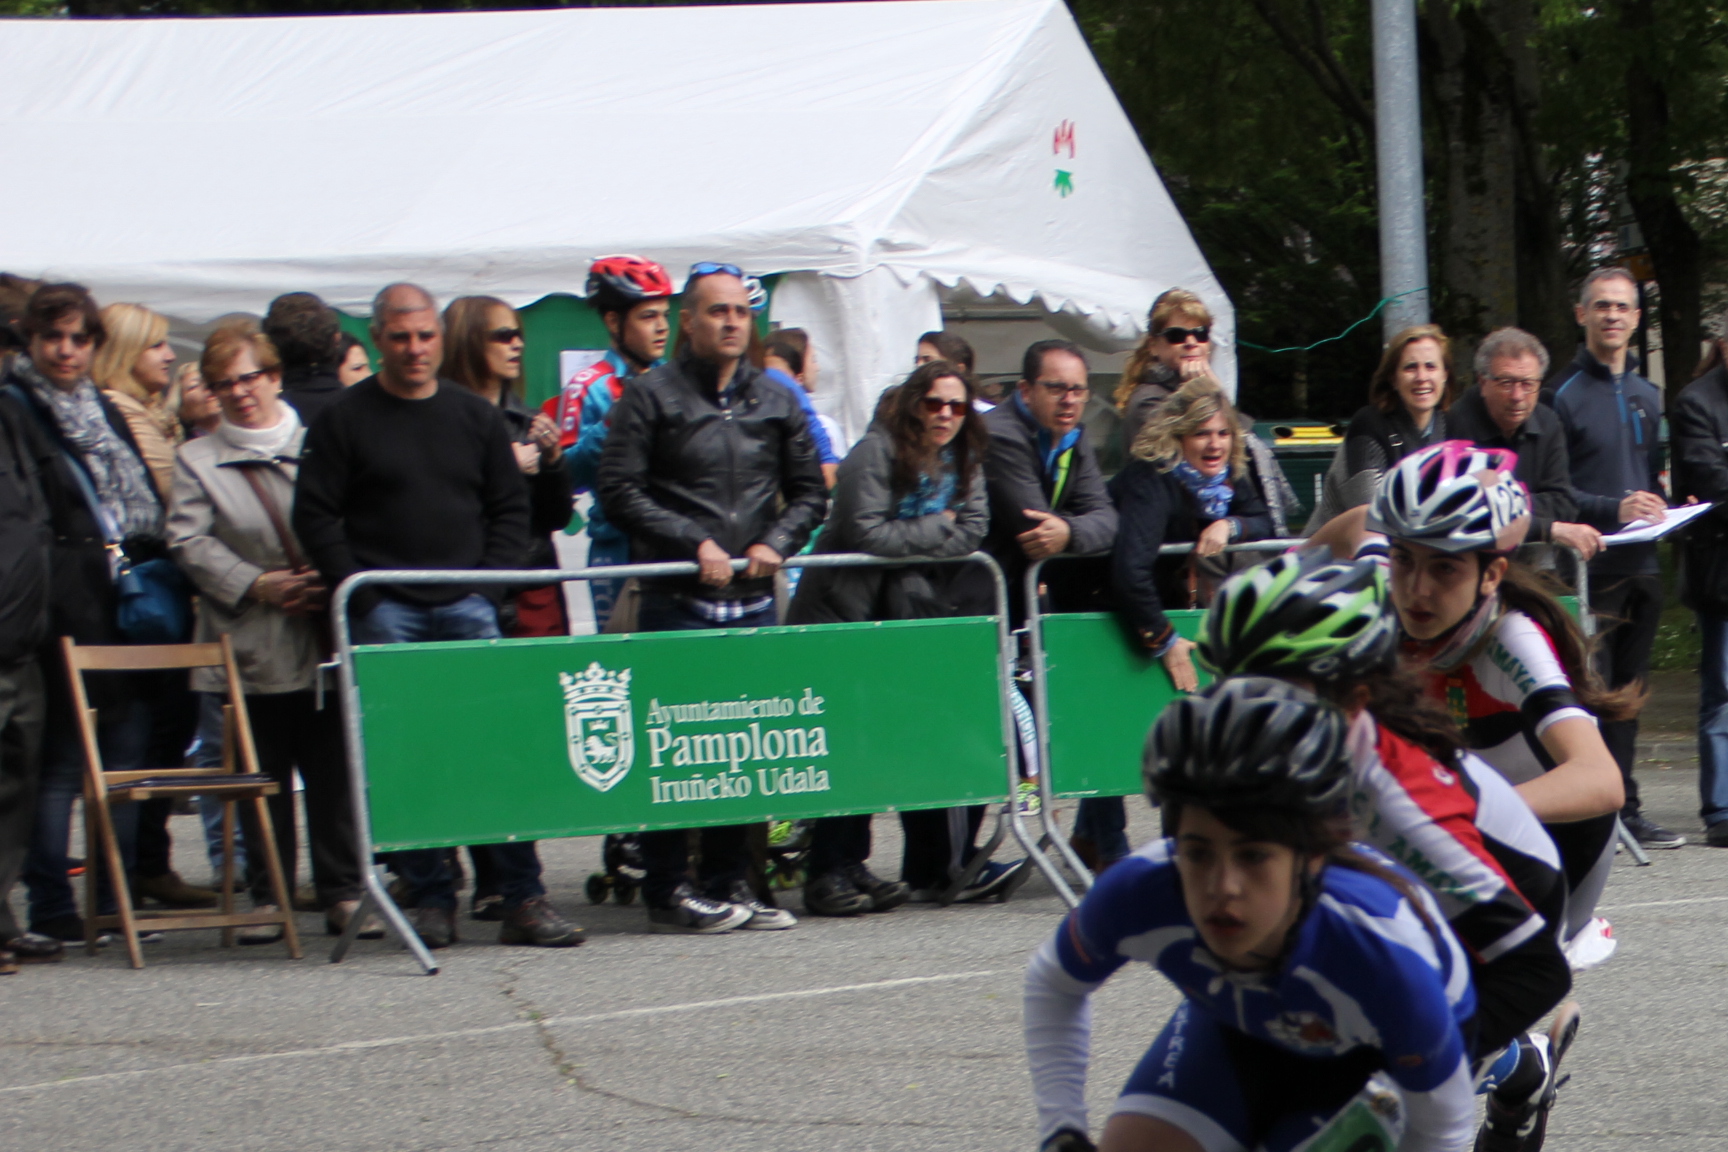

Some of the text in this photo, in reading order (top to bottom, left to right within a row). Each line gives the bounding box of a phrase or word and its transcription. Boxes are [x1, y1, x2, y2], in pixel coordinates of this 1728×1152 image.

[646, 687, 826, 729] Ayuntamiento de
[647, 721, 830, 773] Pamplona
[650, 765, 831, 804] Iruñeko Udala
